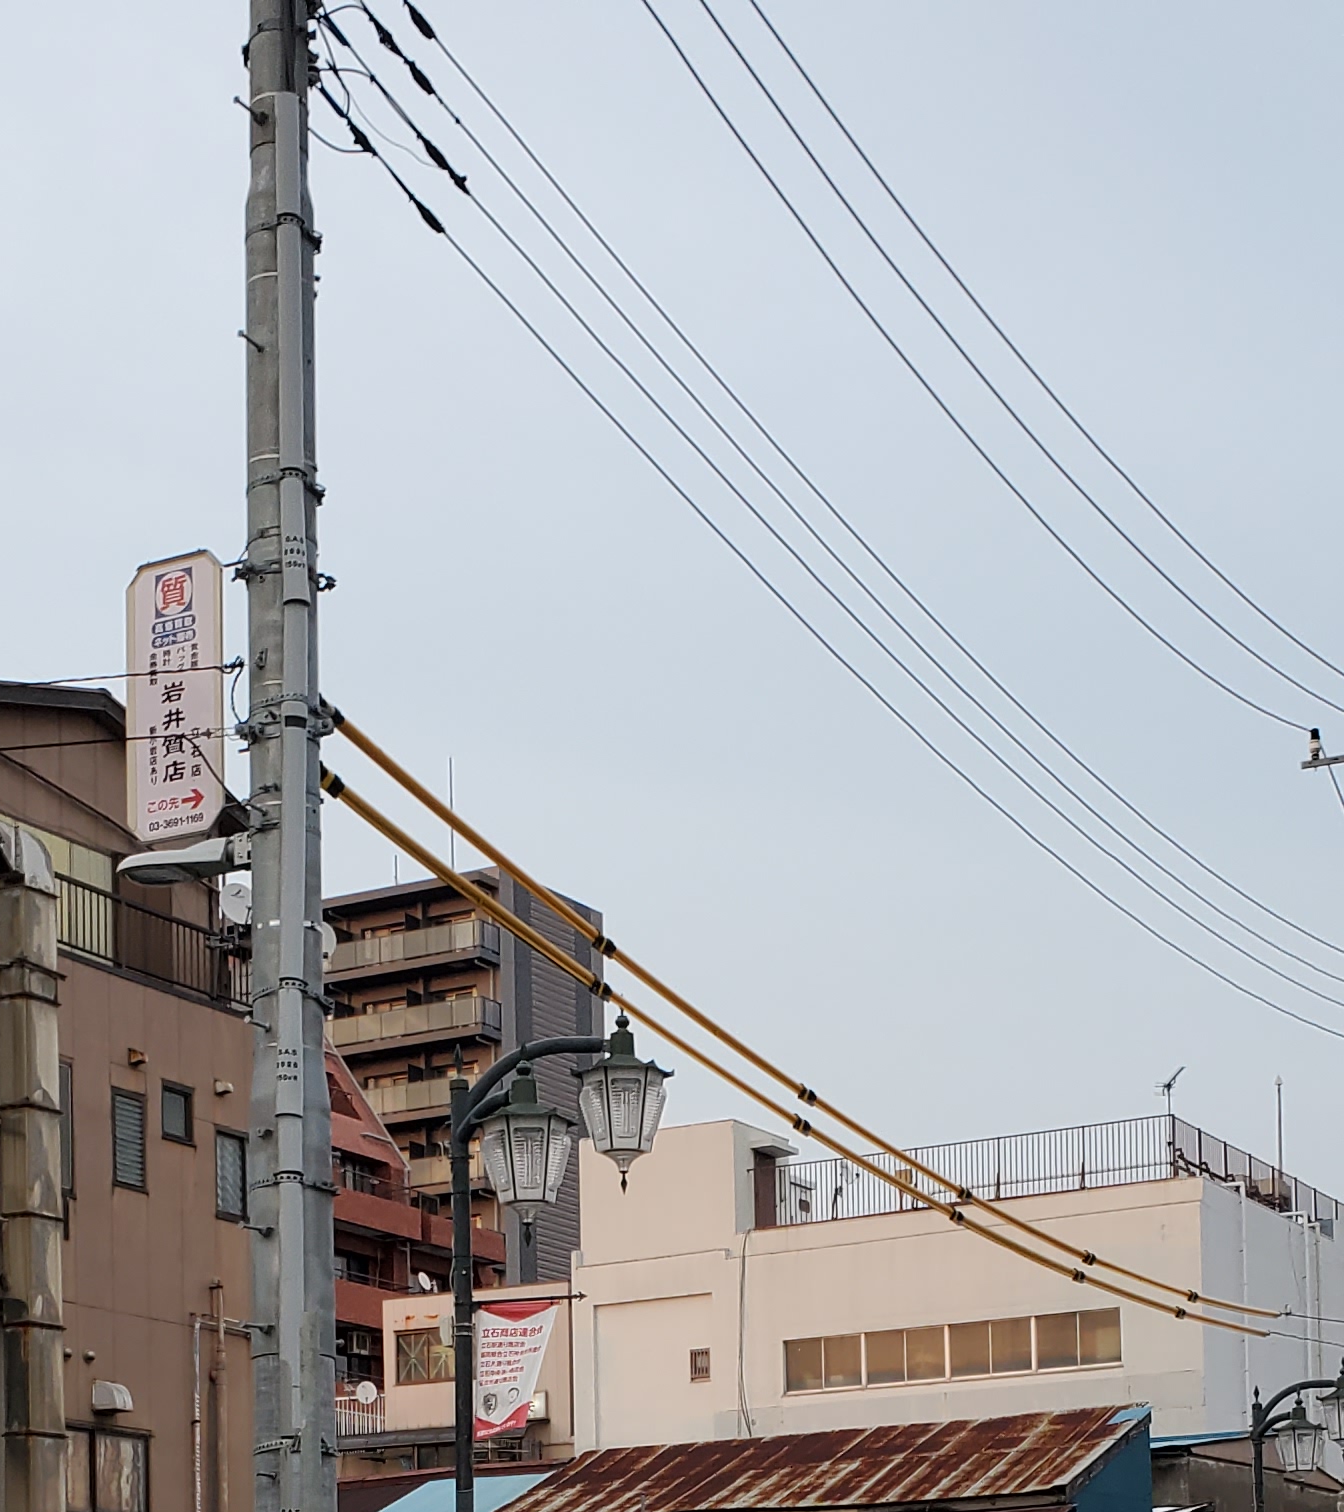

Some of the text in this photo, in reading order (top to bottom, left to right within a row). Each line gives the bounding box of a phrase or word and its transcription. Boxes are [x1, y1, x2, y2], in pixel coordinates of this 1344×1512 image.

[160, 574, 187, 611] 質
[162, 650, 171, 666] 時計
[176, 646, 186, 670] バッグ
[161, 681, 185, 783] 岩井質店
[147, 797, 180, 814] この先
[149, 813, 204, 832] 03-3691-1169
